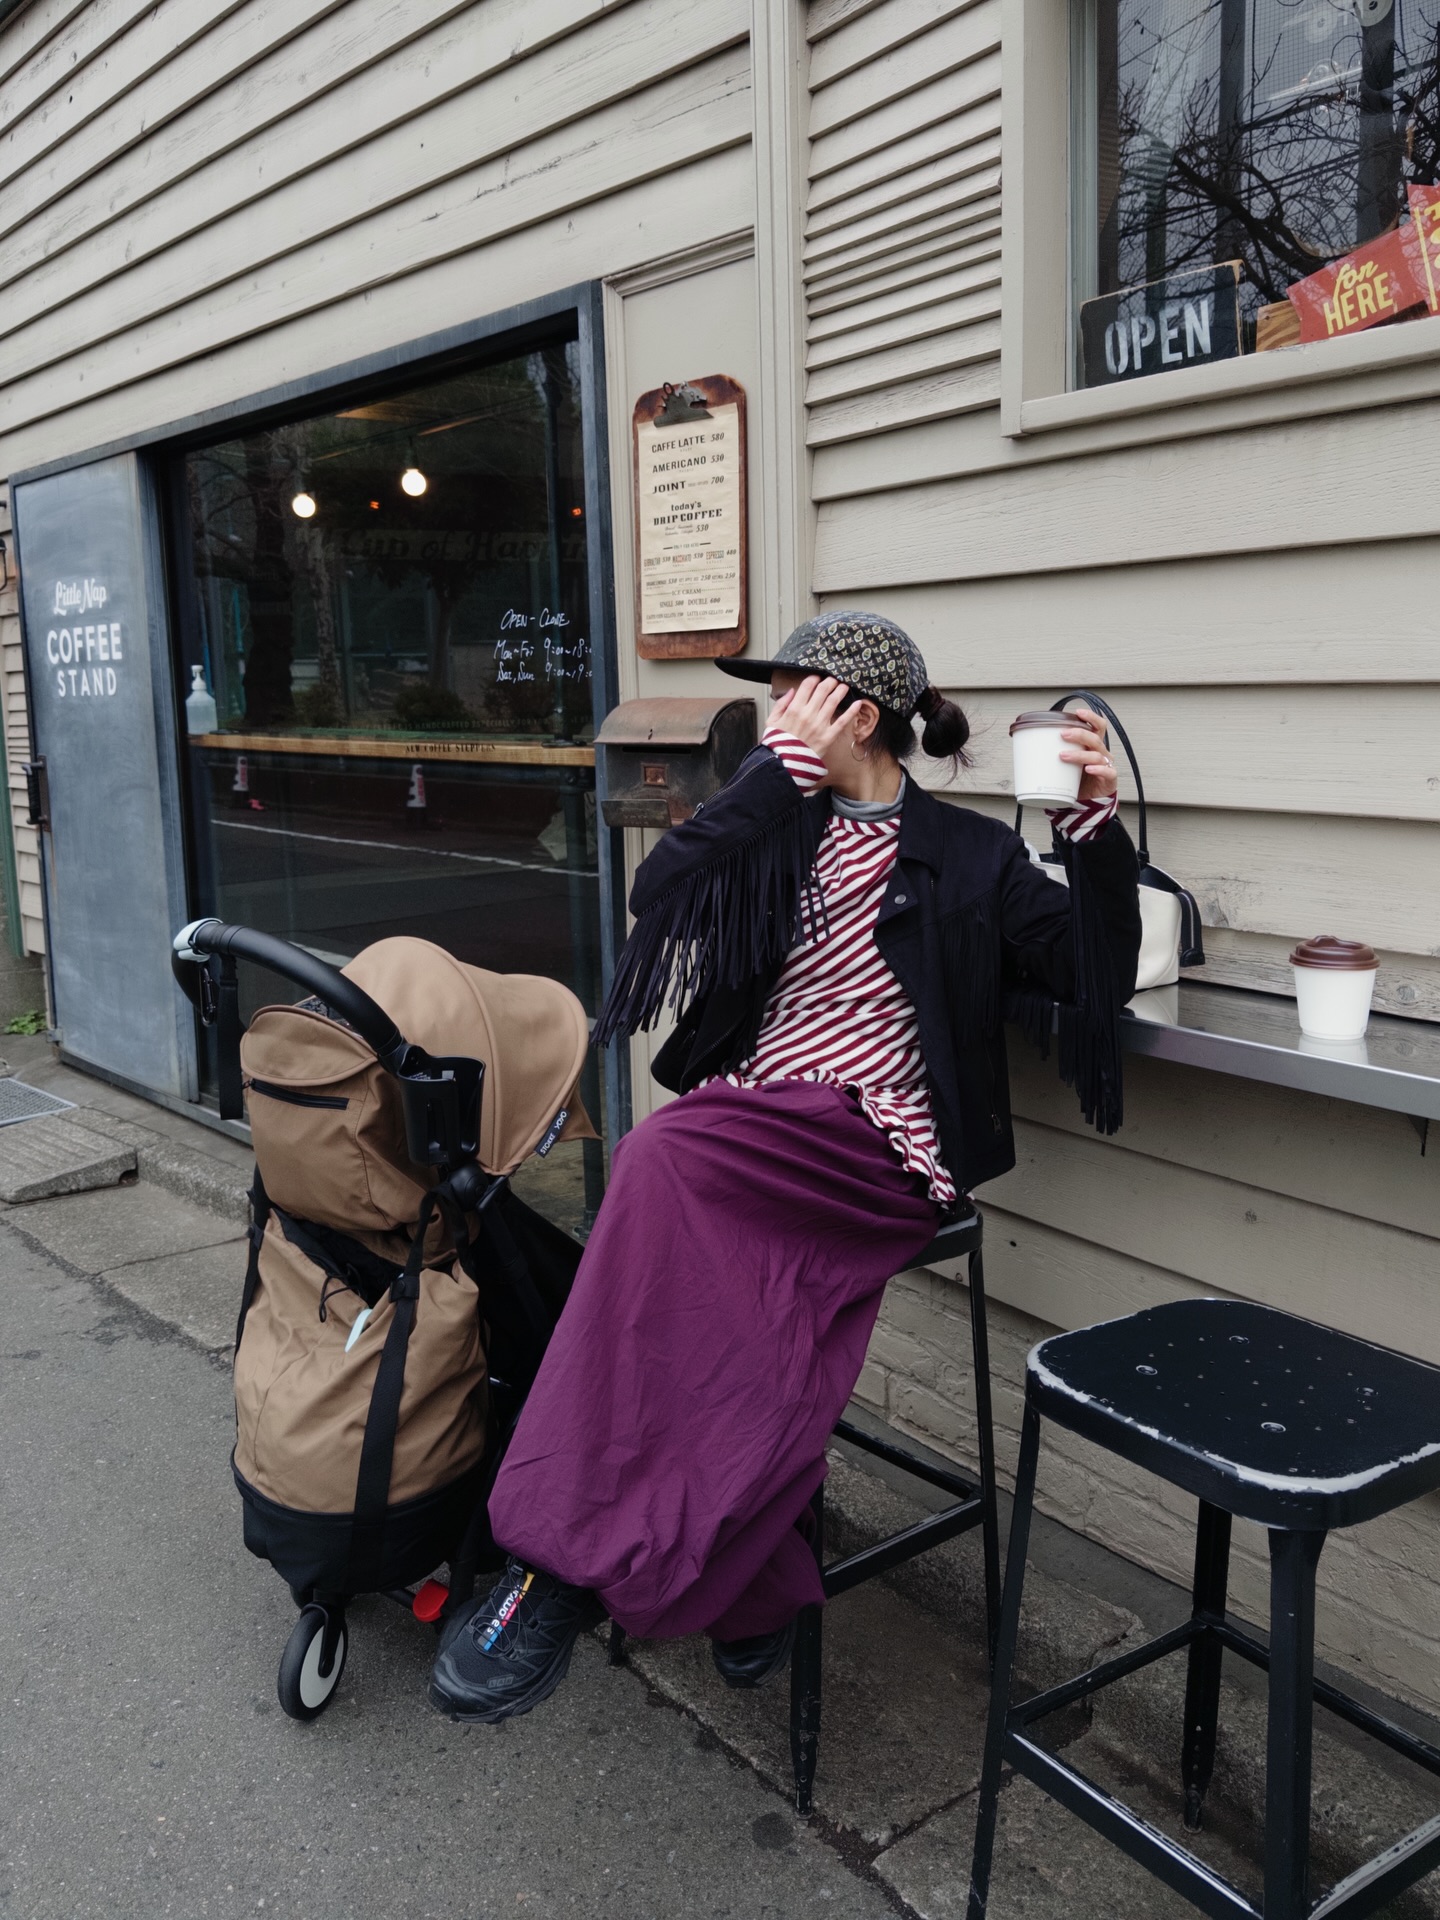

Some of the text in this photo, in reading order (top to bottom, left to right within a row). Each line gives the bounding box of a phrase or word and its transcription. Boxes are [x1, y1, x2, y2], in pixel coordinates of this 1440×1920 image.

[1333, 261, 1378, 302] for
[1323, 272, 1393, 335] HERE
[1105, 300, 1211, 375] OPEN
[652, 432, 725, 453] CAFFE LATTE 580
[652, 453, 725, 473] AMERICANO 530
[652, 480, 686, 494] JOINT
[710, 475, 725, 485] 700
[653, 508, 722, 526] DRIP COFFEE
[671, 500, 702, 511] today's
[695, 523, 709, 533] 530
[53, 578, 107, 616] Little Nap
[47, 623, 123, 665] COFFEE
[57, 667, 117, 698] STAND
